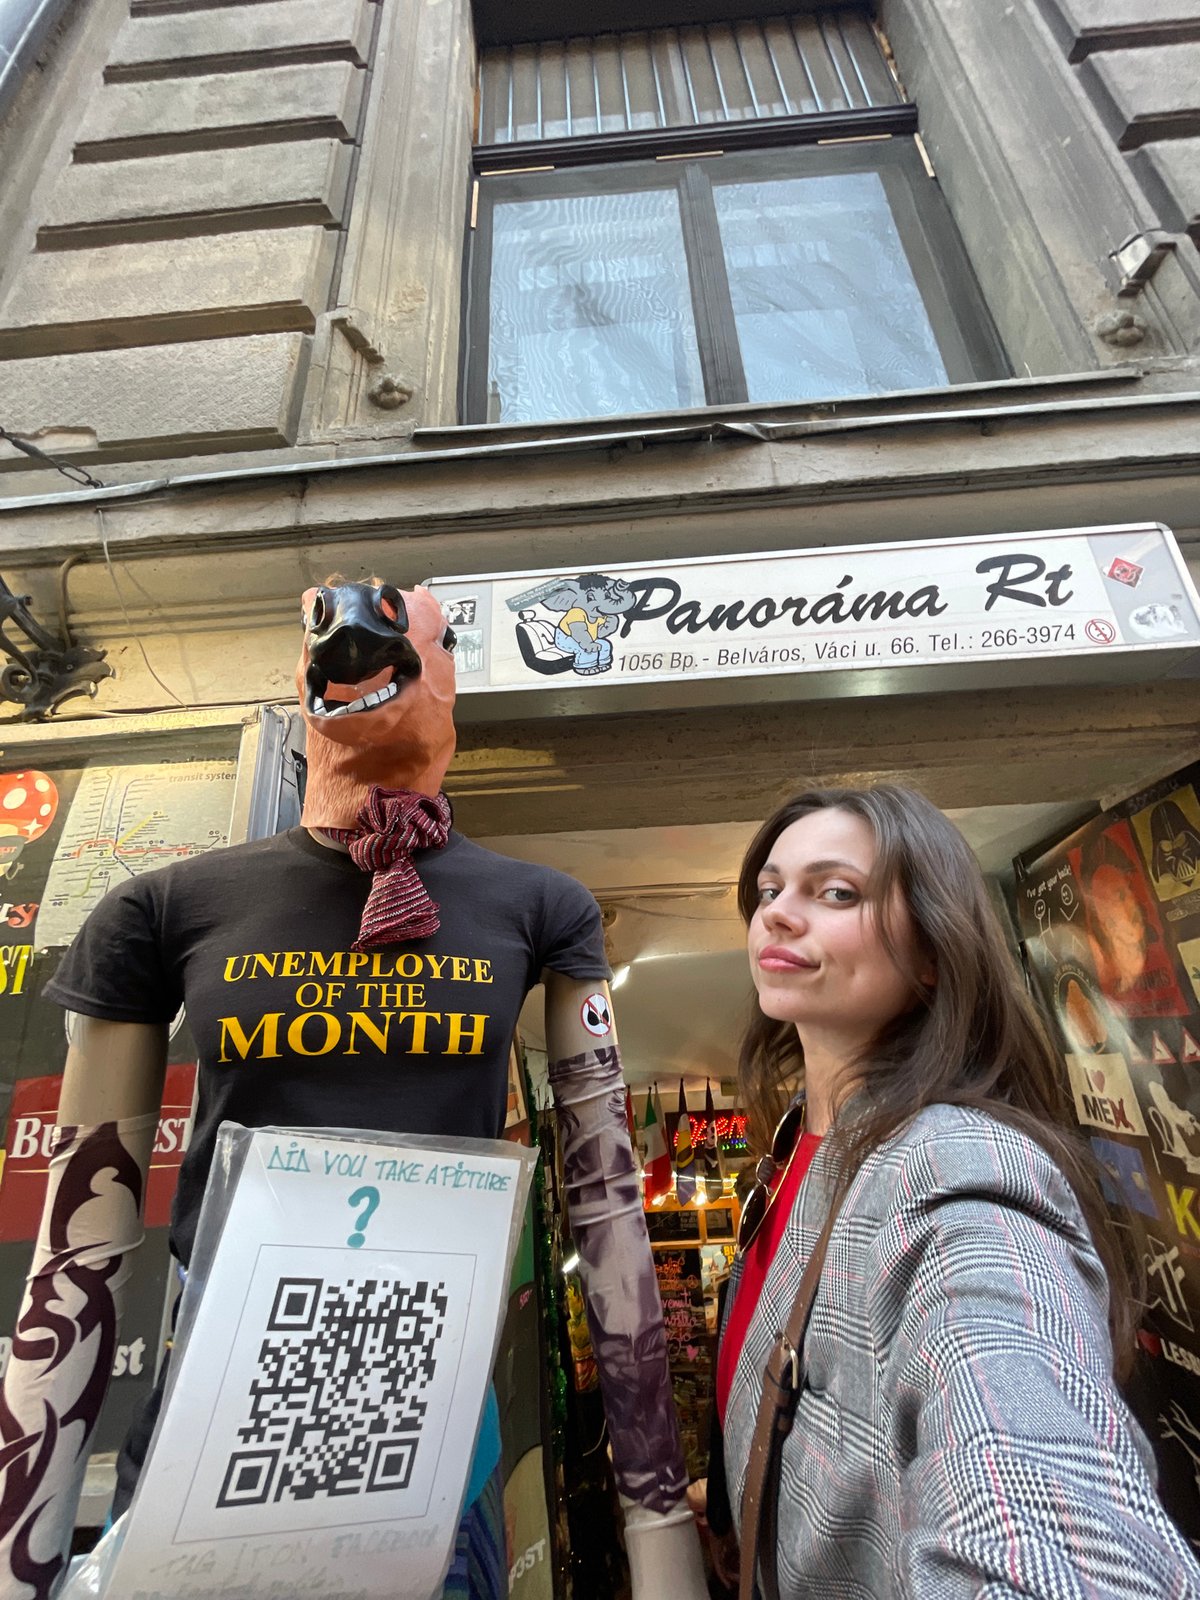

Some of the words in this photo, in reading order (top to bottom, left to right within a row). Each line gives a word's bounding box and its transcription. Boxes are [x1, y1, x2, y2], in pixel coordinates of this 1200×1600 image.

[620, 574, 949, 638] Panoráma
[976, 553, 1074, 611] Rt
[618, 653, 664, 672] 1056
[717, 646, 806, 666] Belváros,
[814, 641, 858, 660] Váci
[864, 643, 882, 657] u.
[890, 637, 920, 655] 66.
[980, 623, 1077, 649] 266-3974
[222, 951, 494, 984] UNEMPLOYEE
[295, 982, 346, 1009] OF
[356, 983, 427, 1008] THE
[217, 1011, 491, 1063] MONTH
[375, 1160, 424, 1183] TAKE
[425, 1164, 439, 1185] A
[441, 1161, 512, 1192] PICTURE
[347, 1185, 381, 1249] ?
